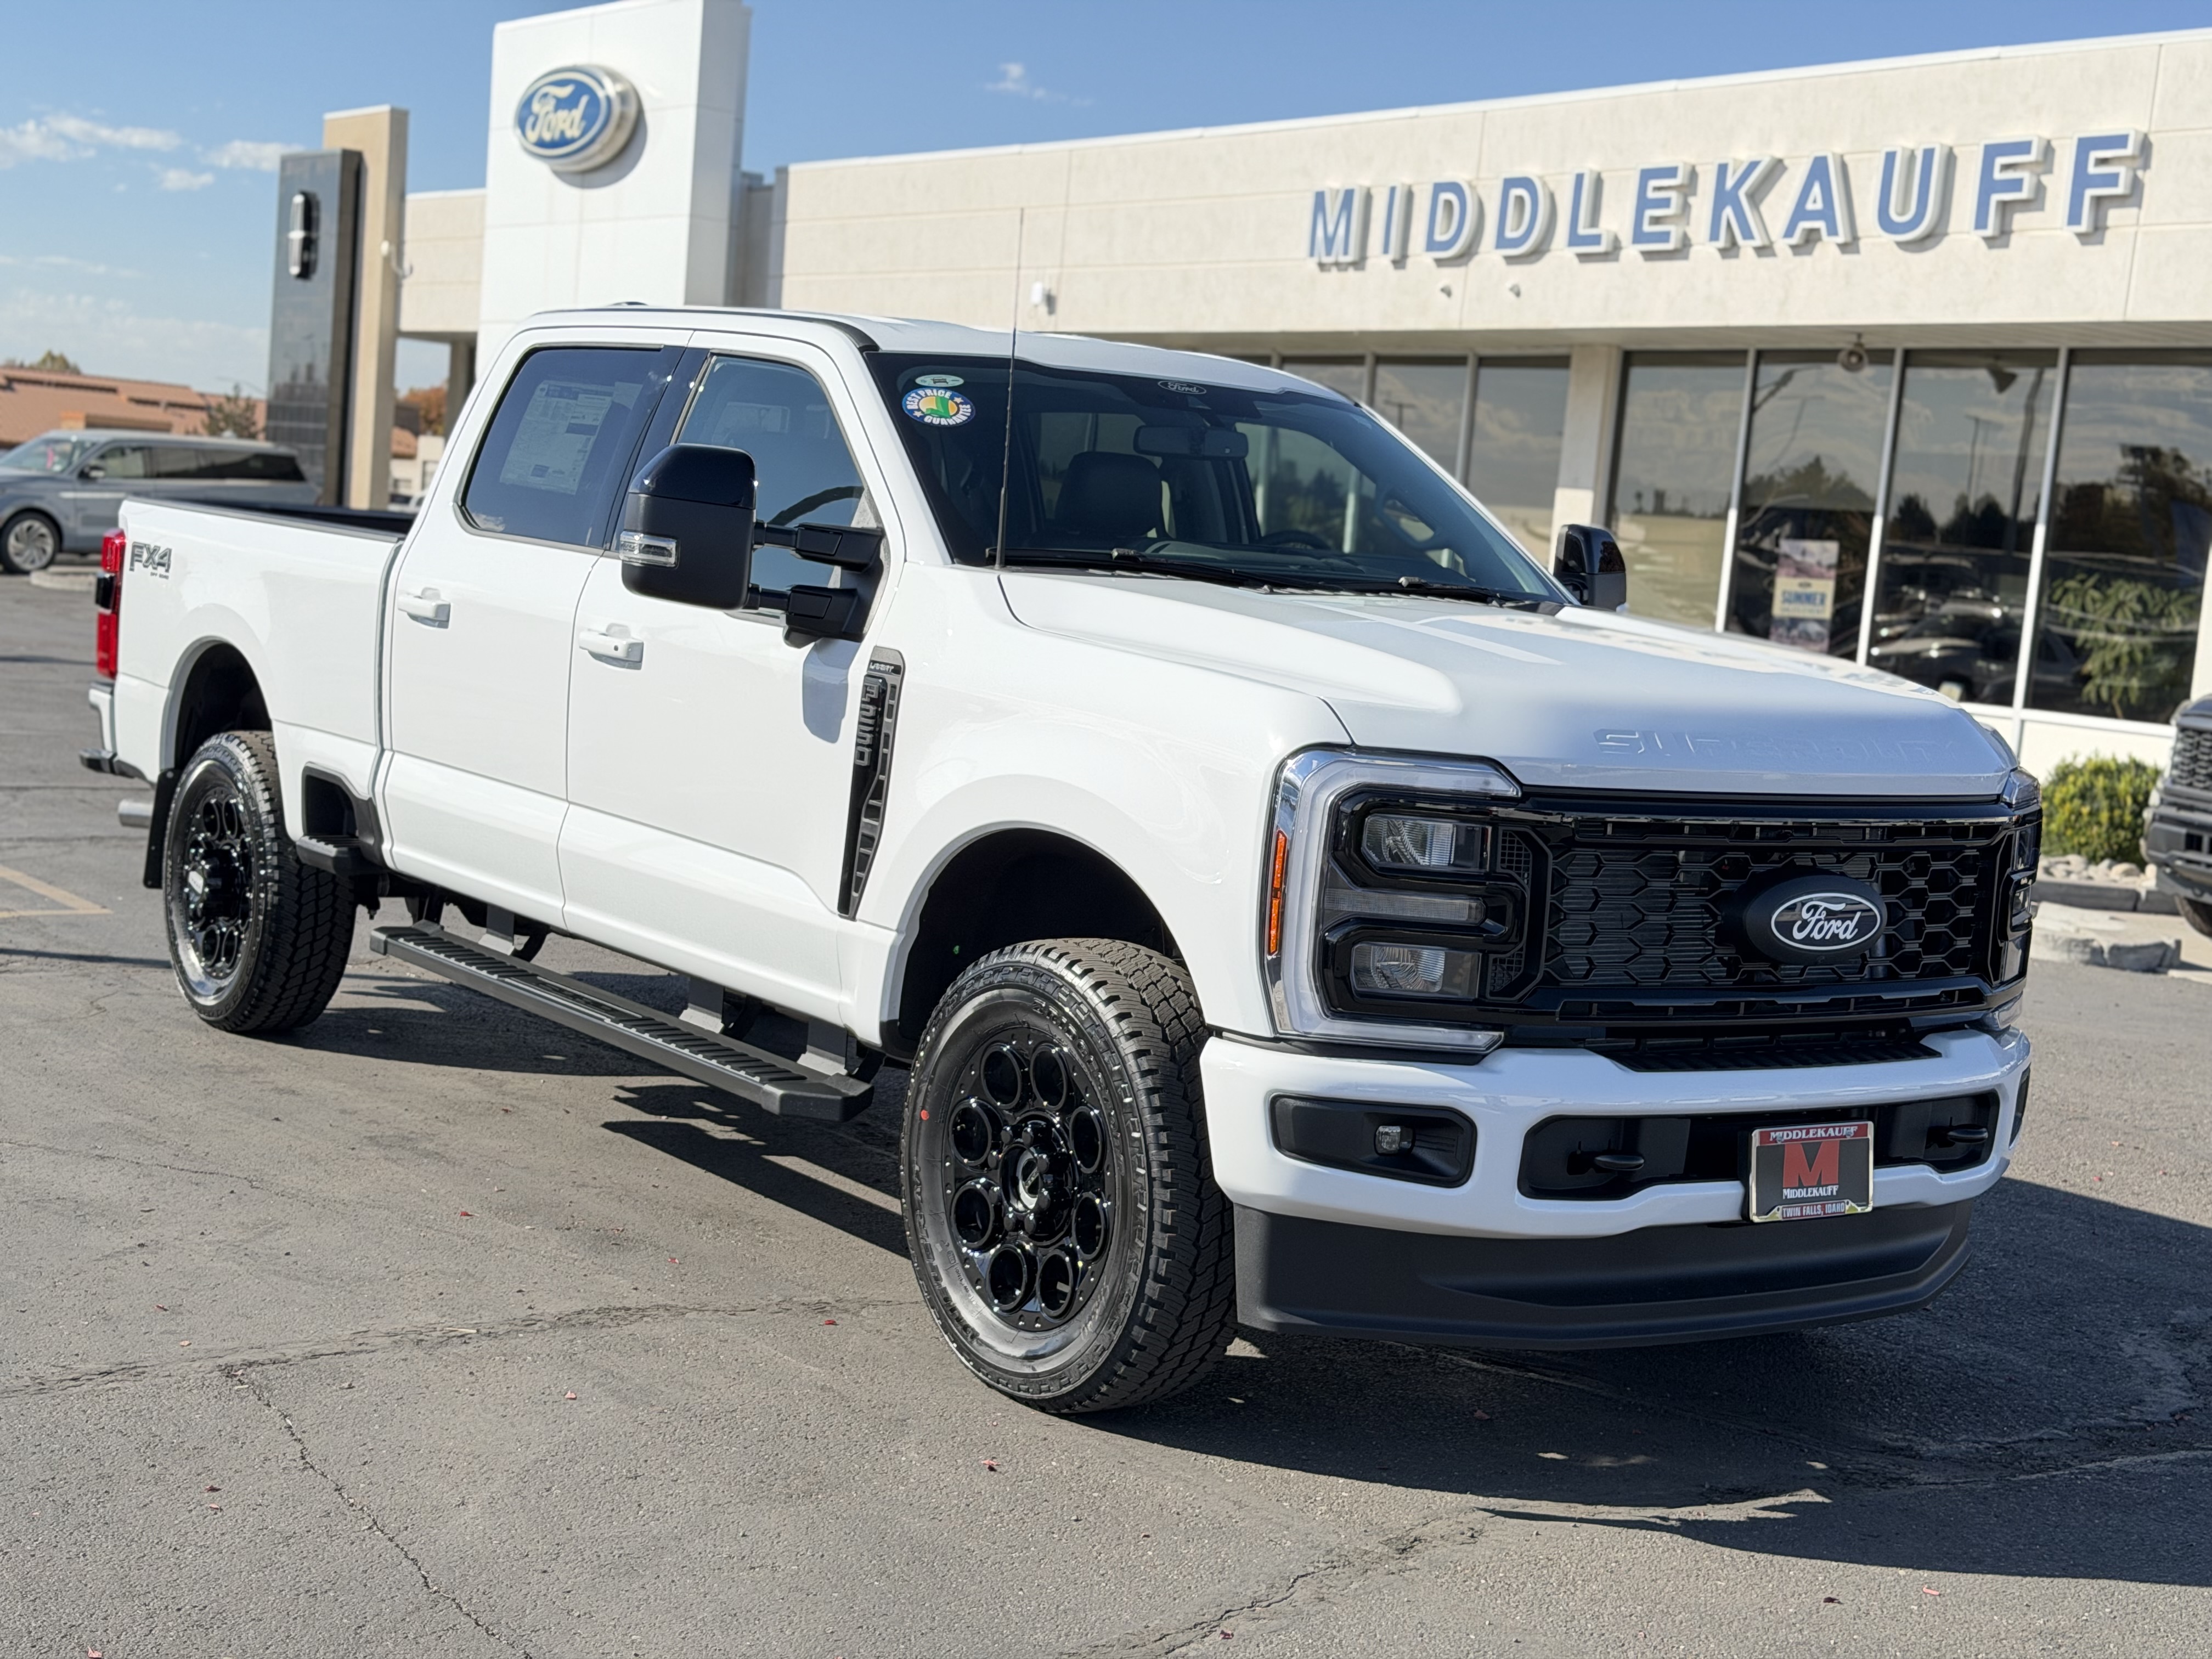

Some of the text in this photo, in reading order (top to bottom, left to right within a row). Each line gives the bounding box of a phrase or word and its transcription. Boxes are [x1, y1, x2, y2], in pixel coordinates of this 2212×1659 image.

[525, 84, 590, 144] Ford
[1308, 129, 2141, 263] MIDDLEKAUFF
[906, 388, 952, 410] BEST PRICE
[1167, 382, 1199, 393] Ford
[924, 404, 972, 425] GUARANTEE
[129, 541, 173, 573] FX4
[1792, 900, 1861, 940] Ford
[1783, 1140, 1840, 1187] M
[1782, 1185, 1839, 1199] MIDDLEKAUFF
[1782, 1203, 1845, 1218] TWIN FALLS, IDAHO
